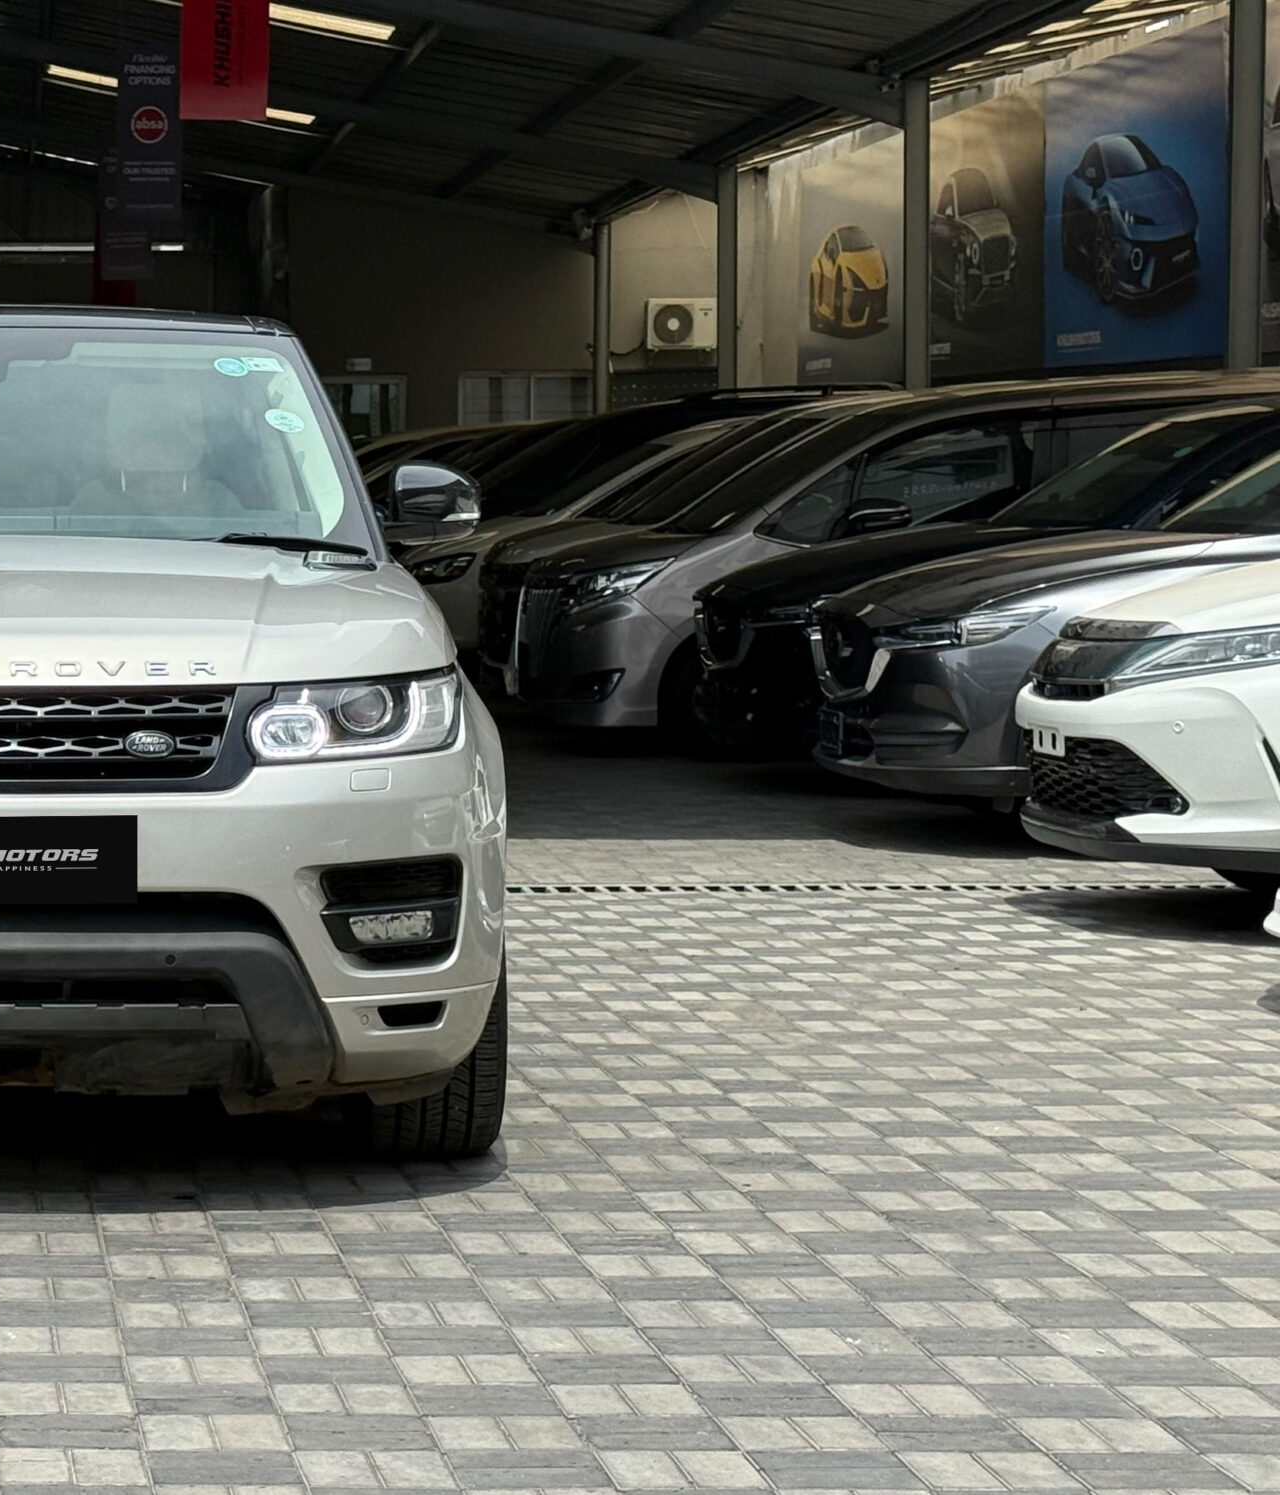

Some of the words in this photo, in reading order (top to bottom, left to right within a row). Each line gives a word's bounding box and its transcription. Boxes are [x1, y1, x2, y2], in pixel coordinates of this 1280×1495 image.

[123, 64, 176, 74] FINANCING
[128, 76, 172, 86] OPTIONS
[135, 116, 164, 129] absa
[8, 659, 217, 678] ROVER
[135, 735, 160, 744] LAND
[136, 743, 167, 752] ROVER
